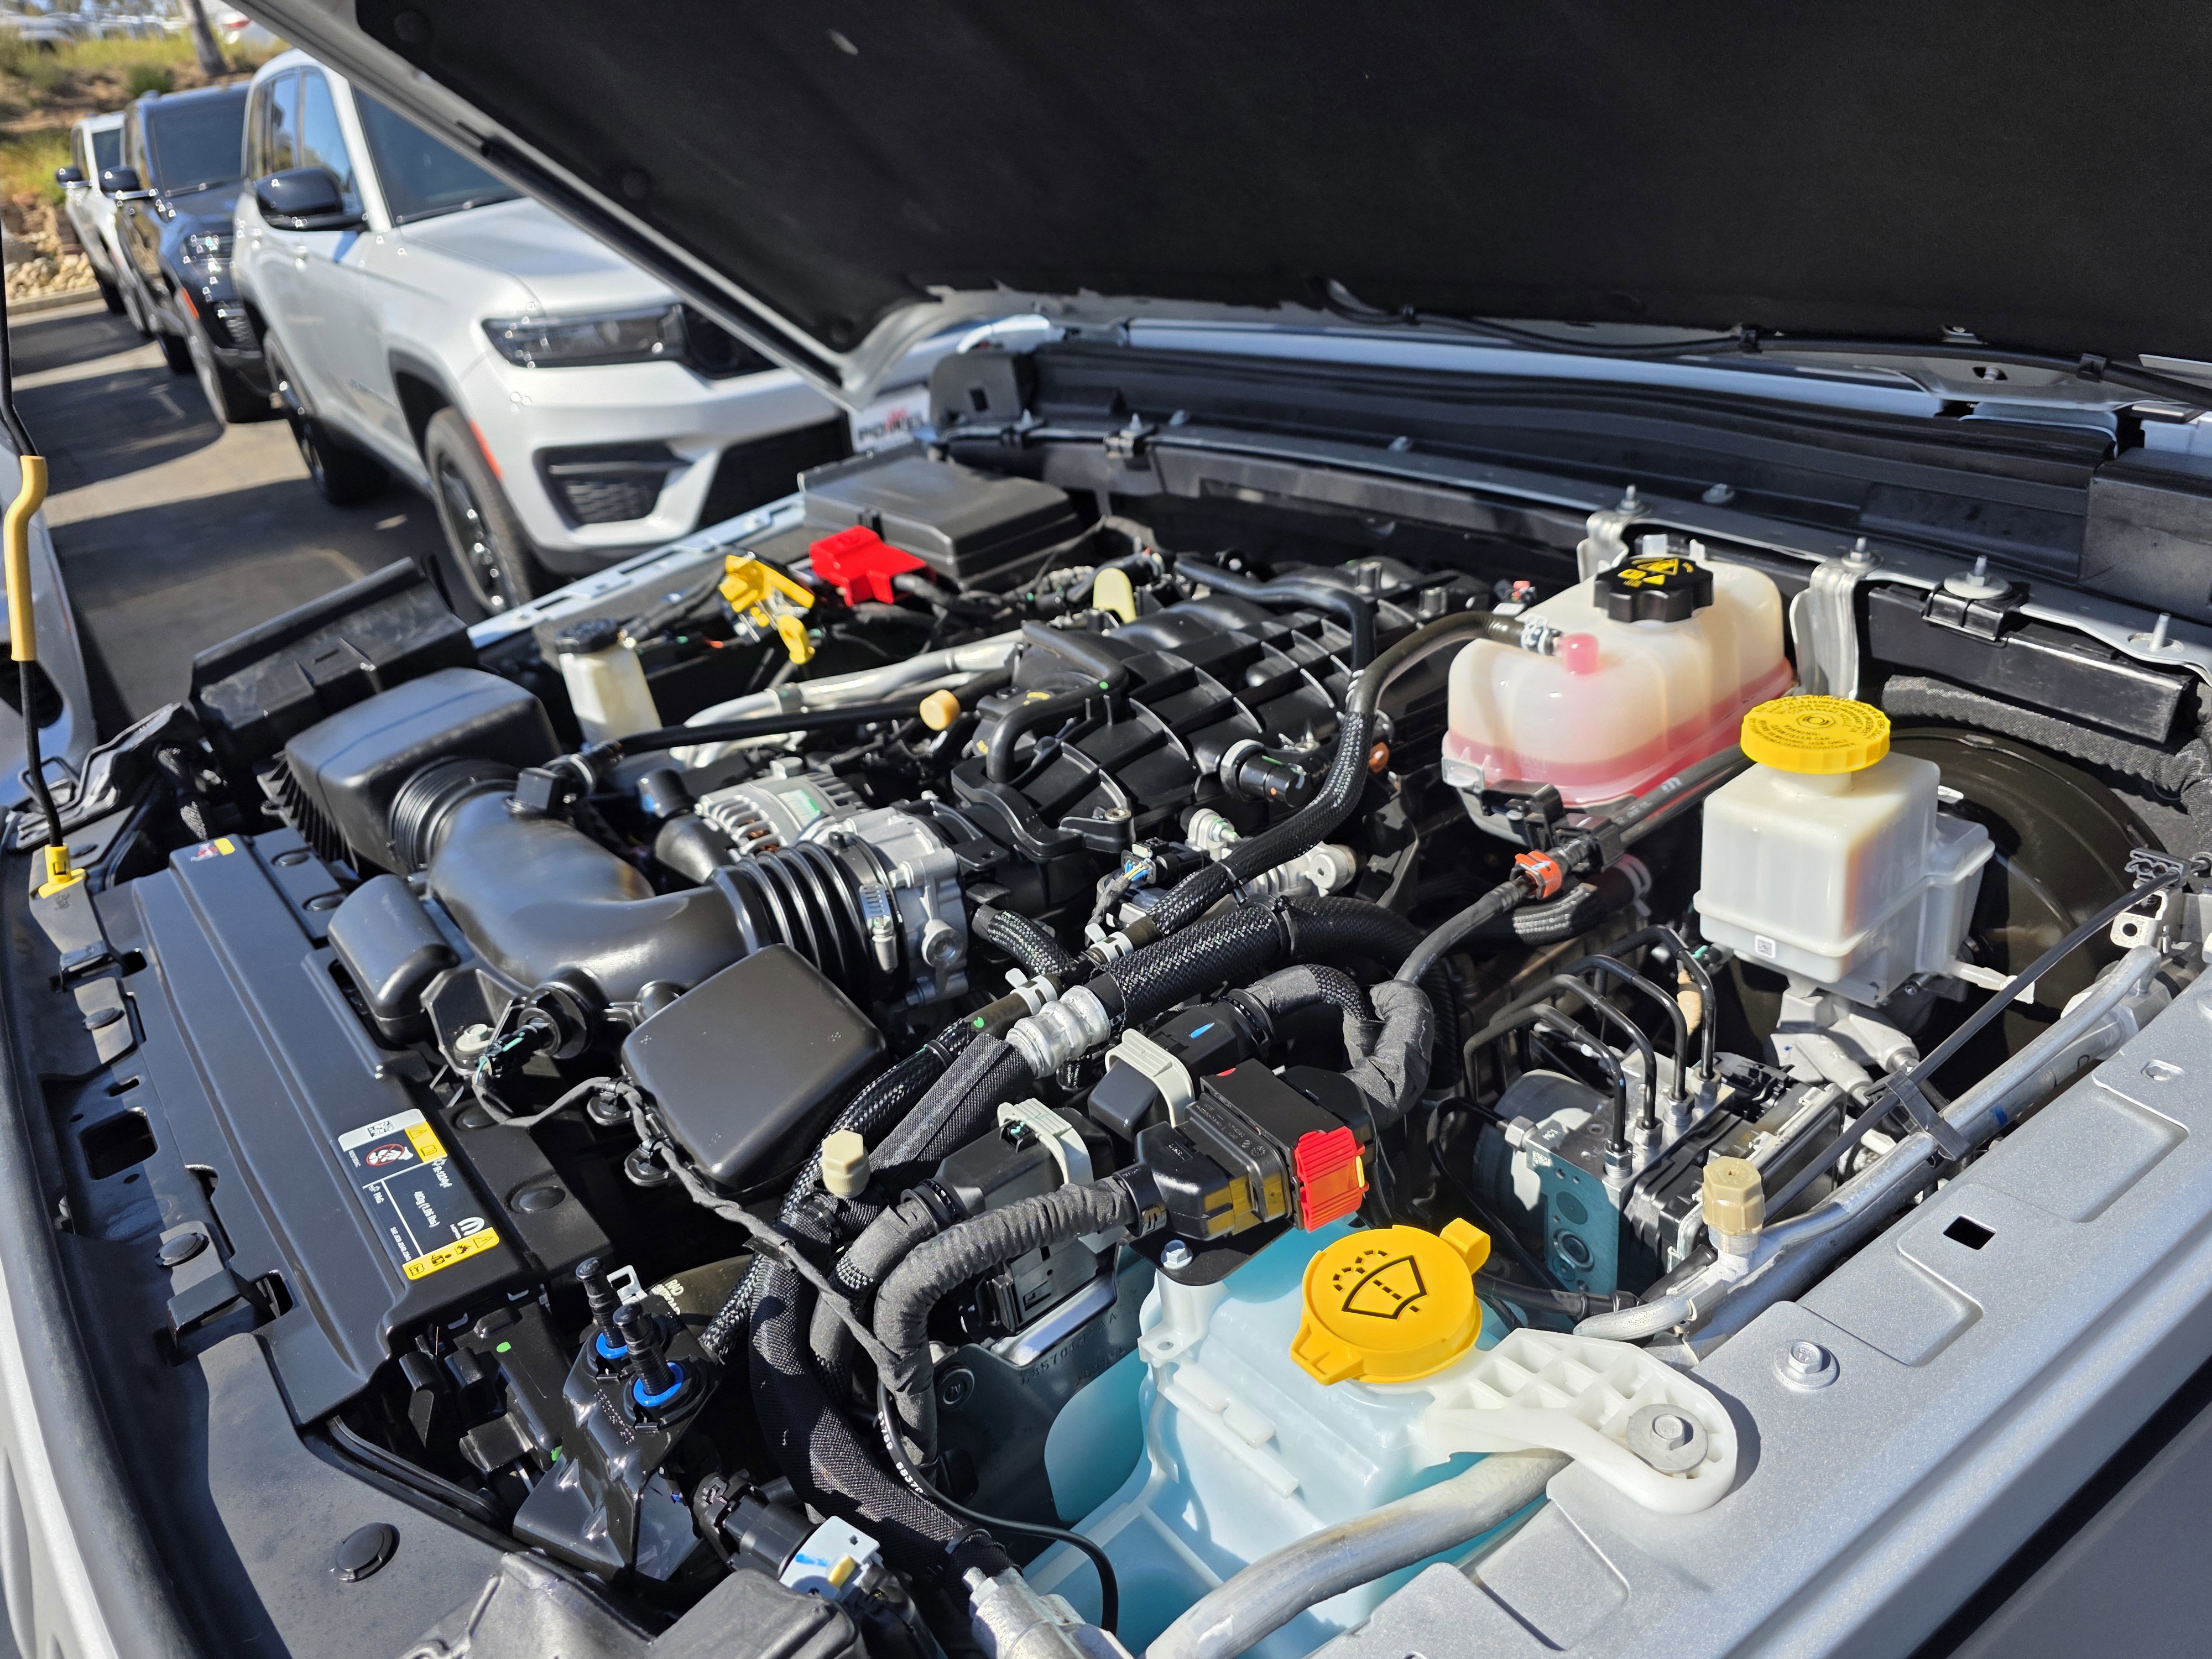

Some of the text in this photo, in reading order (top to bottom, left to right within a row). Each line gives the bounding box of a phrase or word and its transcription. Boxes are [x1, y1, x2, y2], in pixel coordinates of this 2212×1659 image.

[433, 1166, 452, 1188] R-1234yf
[373, 1192, 384, 1204] PAG
[419, 1203, 434, 1217] (1.06
[427, 1215, 440, 1228] lbs)
[665, 1279, 684, 1296] RAD
